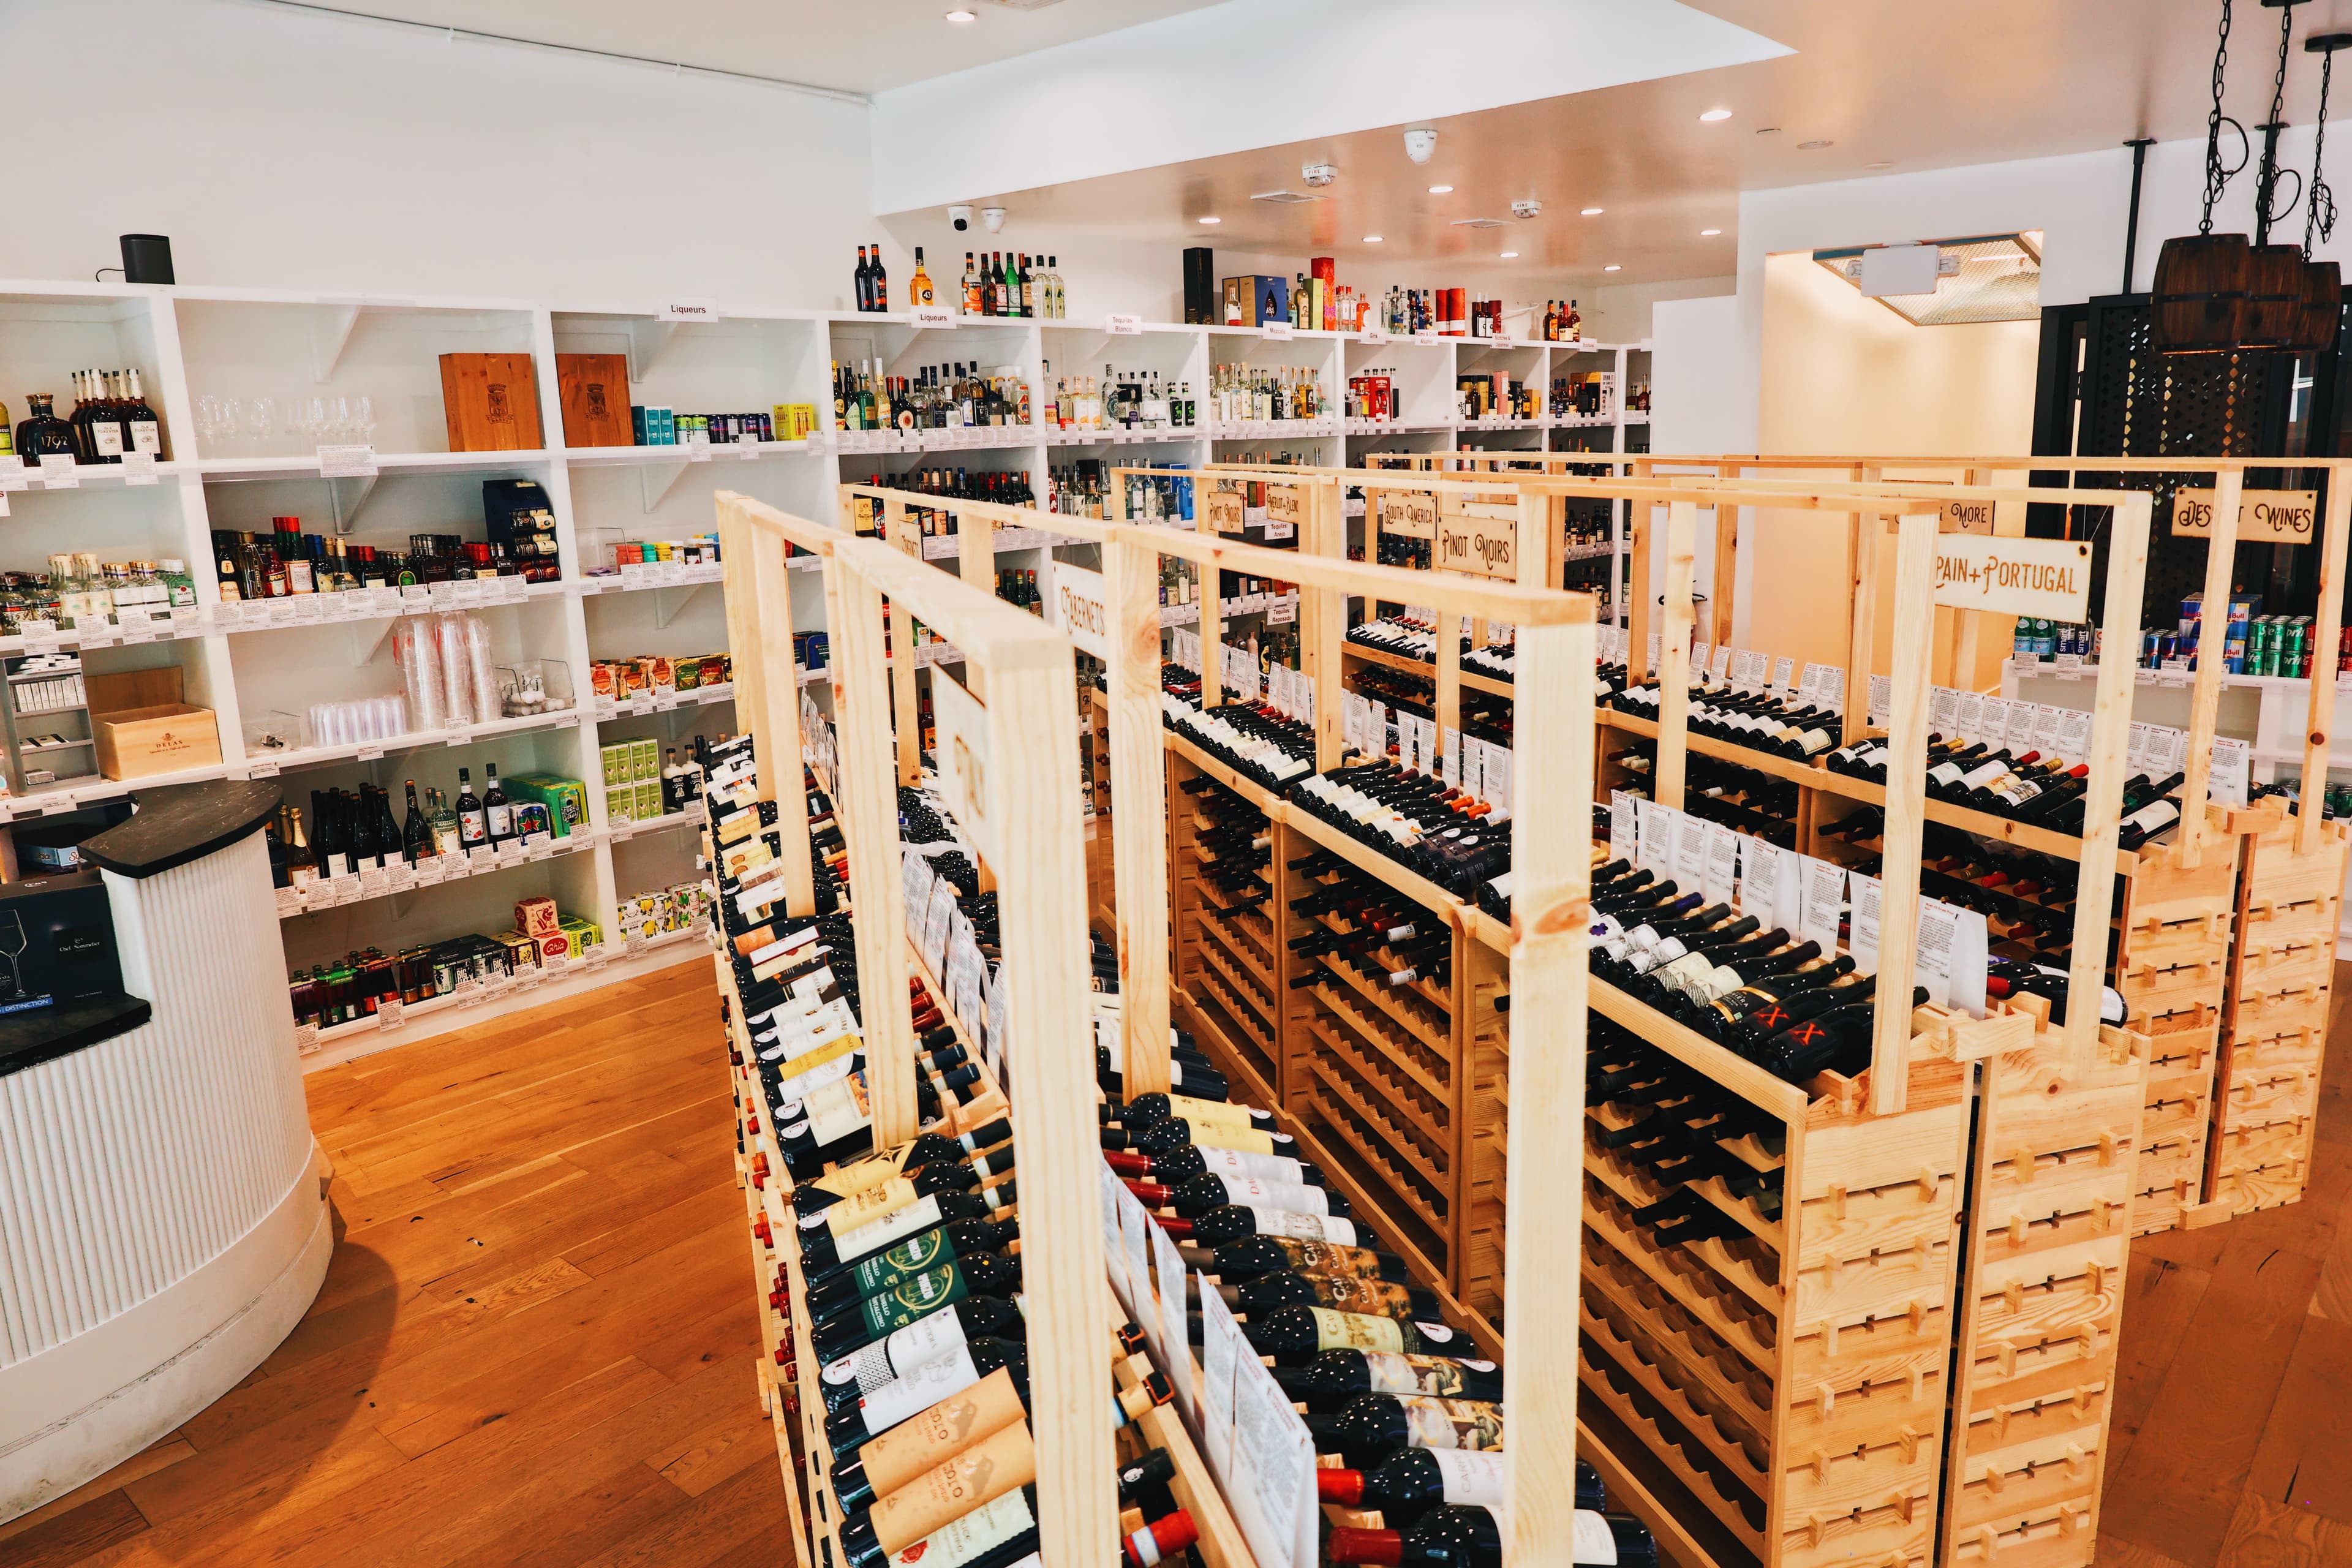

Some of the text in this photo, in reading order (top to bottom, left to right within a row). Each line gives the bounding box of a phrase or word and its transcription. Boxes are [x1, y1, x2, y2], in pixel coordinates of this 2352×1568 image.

[671, 304, 706, 315] Liqueurs
[920, 314, 948, 323] Liqueurs
[1112, 316, 1133, 325] Tequilas
[40, 435, 68, 450] 1792
[1267, 494, 1283, 512] MERLOT
[1210, 502, 1240, 528] PINOT NOIRS
[1384, 502, 1433, 527] SOUTH AMERICA
[1951, 503, 1988, 528] MORE
[2255, 503, 2311, 533] WINES
[1442, 529, 1509, 570] PINOT NOIRS
[1936, 556, 1968, 589] PAIN
[1983, 555, 2077, 595] PORTUGAL
[1061, 586, 1105, 635] CABERNETS
[1272, 615, 1292, 624] Reposado
[156, 740, 183, 748] DELAS
[74, 941, 100, 949] Sommelier
[546, 941, 565, 953] Ghia
[494, 958, 503, 970] BIG
[457, 968, 467, 980] BIG
[5, 998, 49, 1012] DISTINCTION
